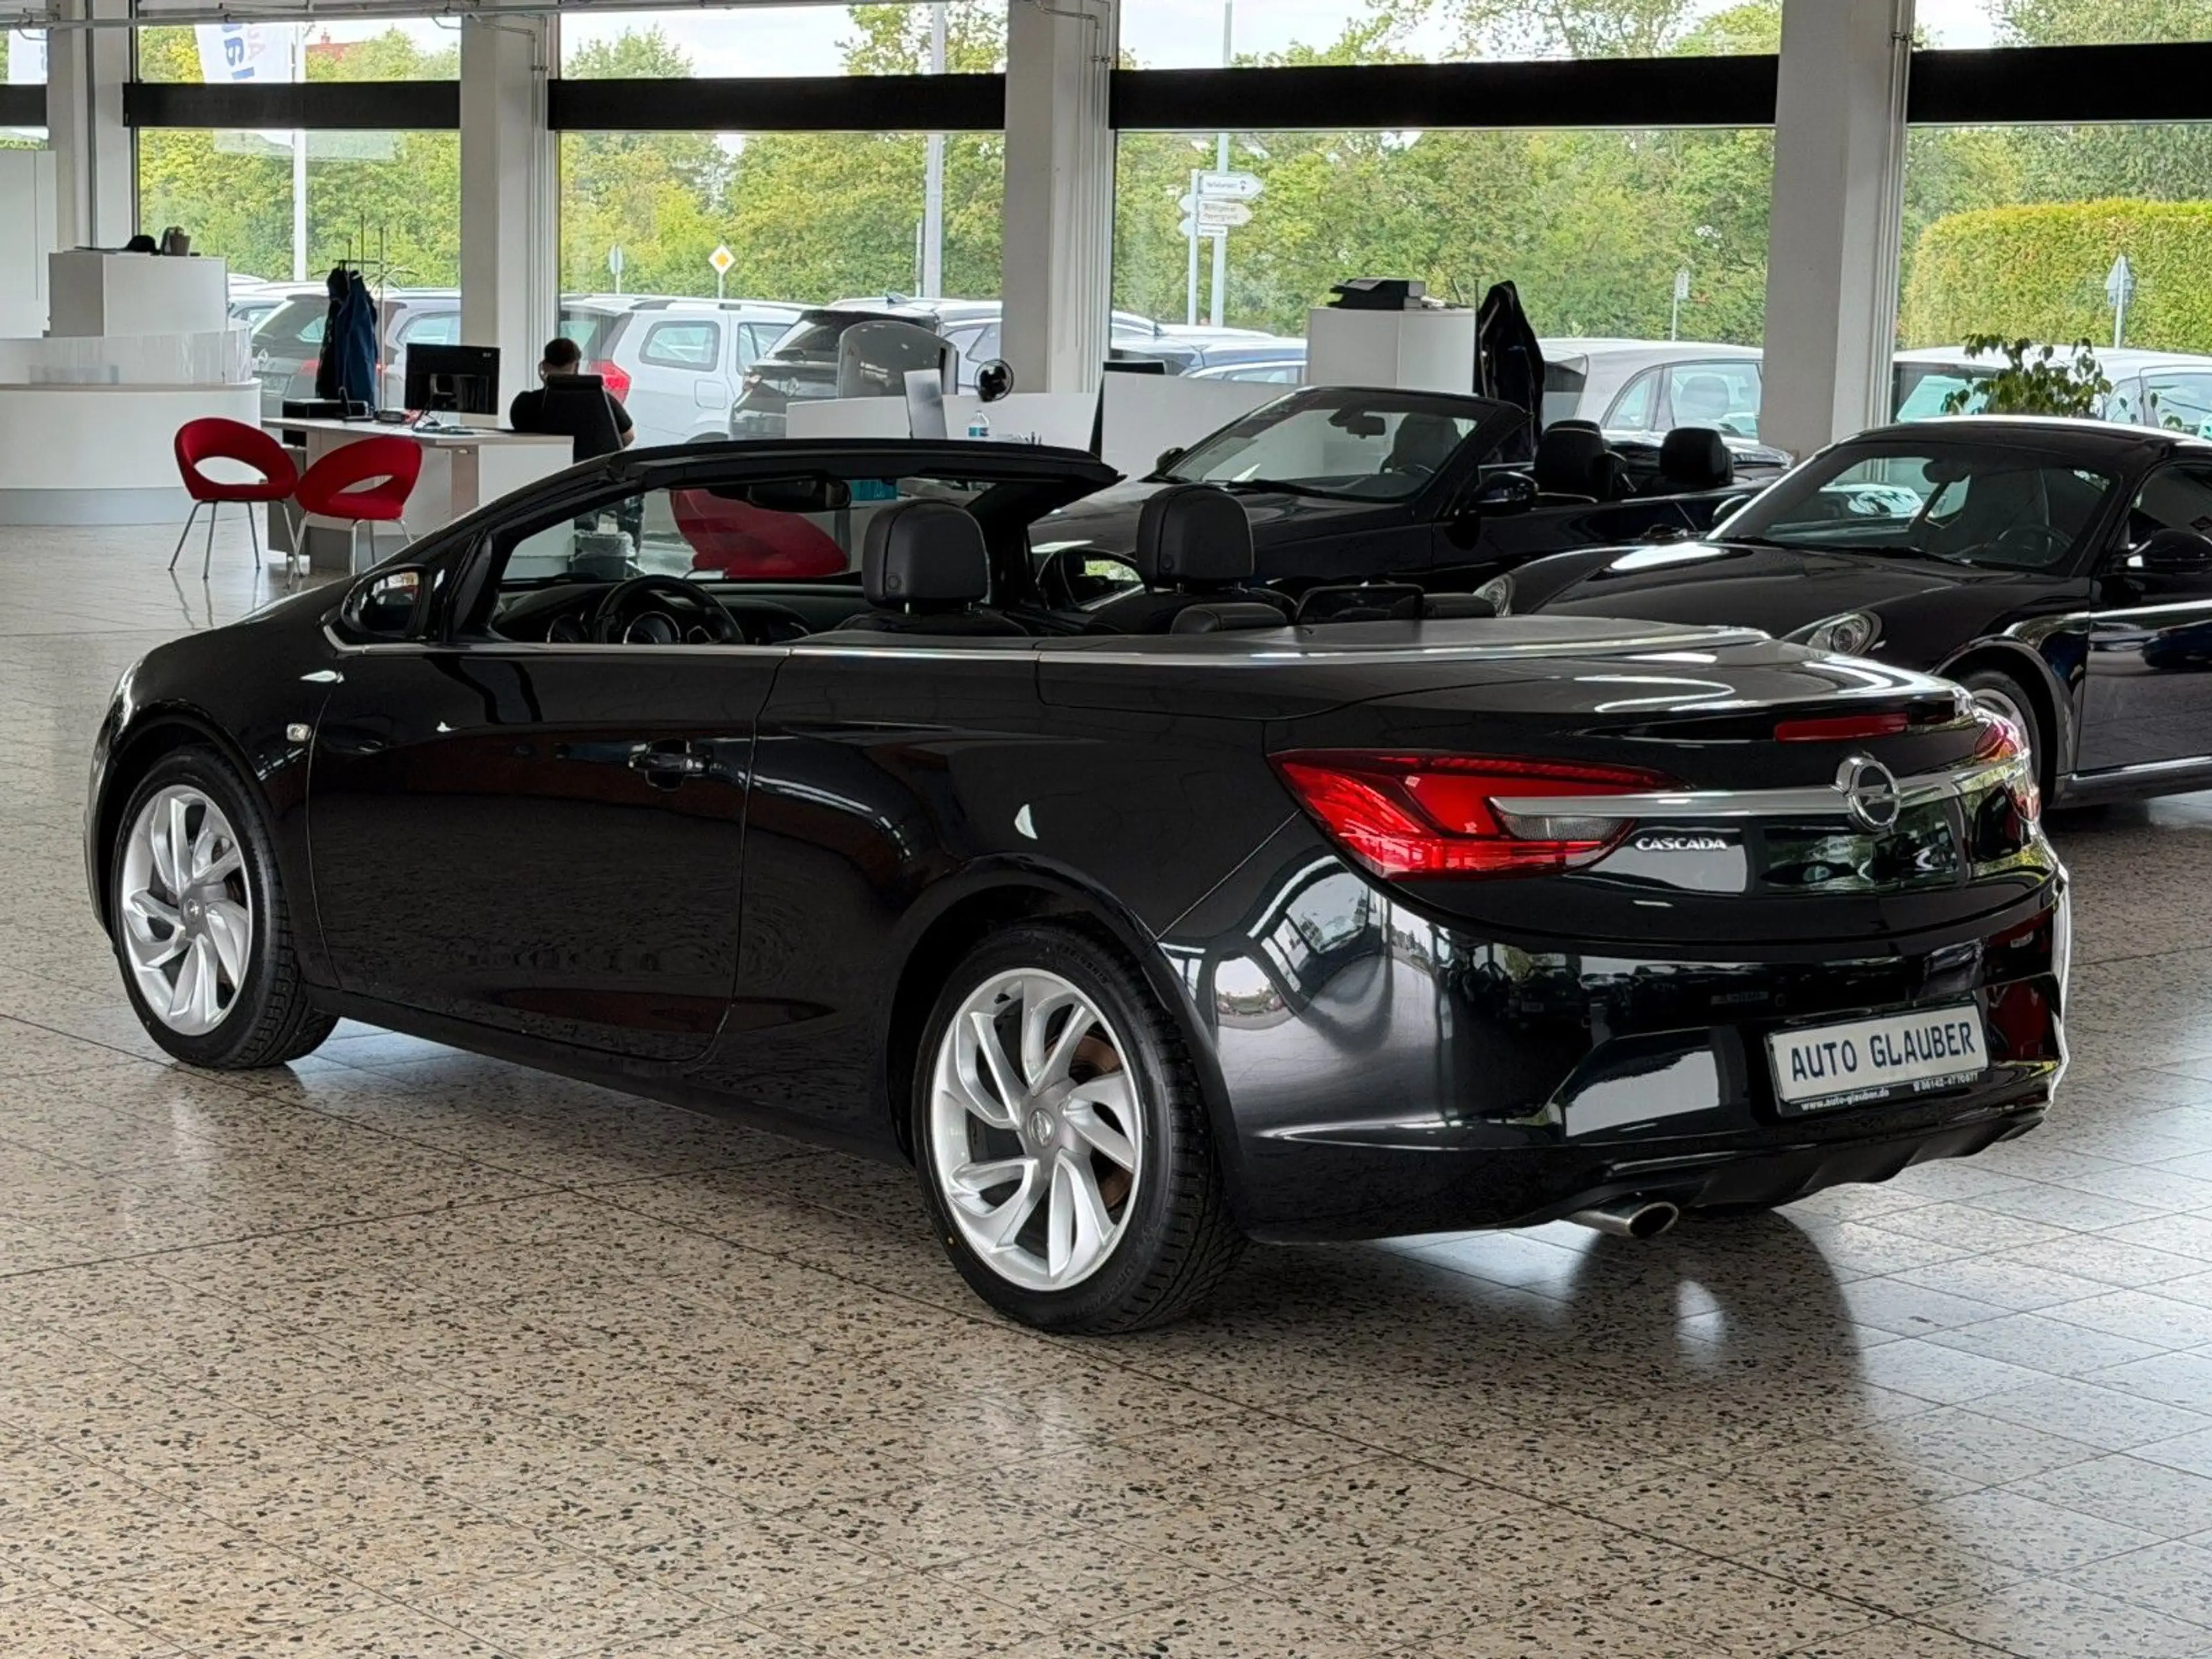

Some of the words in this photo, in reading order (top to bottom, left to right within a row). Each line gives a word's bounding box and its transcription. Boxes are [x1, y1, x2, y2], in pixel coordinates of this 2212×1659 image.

[1635, 838, 1728, 850] CASCADA
[1792, 1040, 1858, 1081] AUTO
[1870, 1022, 1976, 1067] GLAUBER
